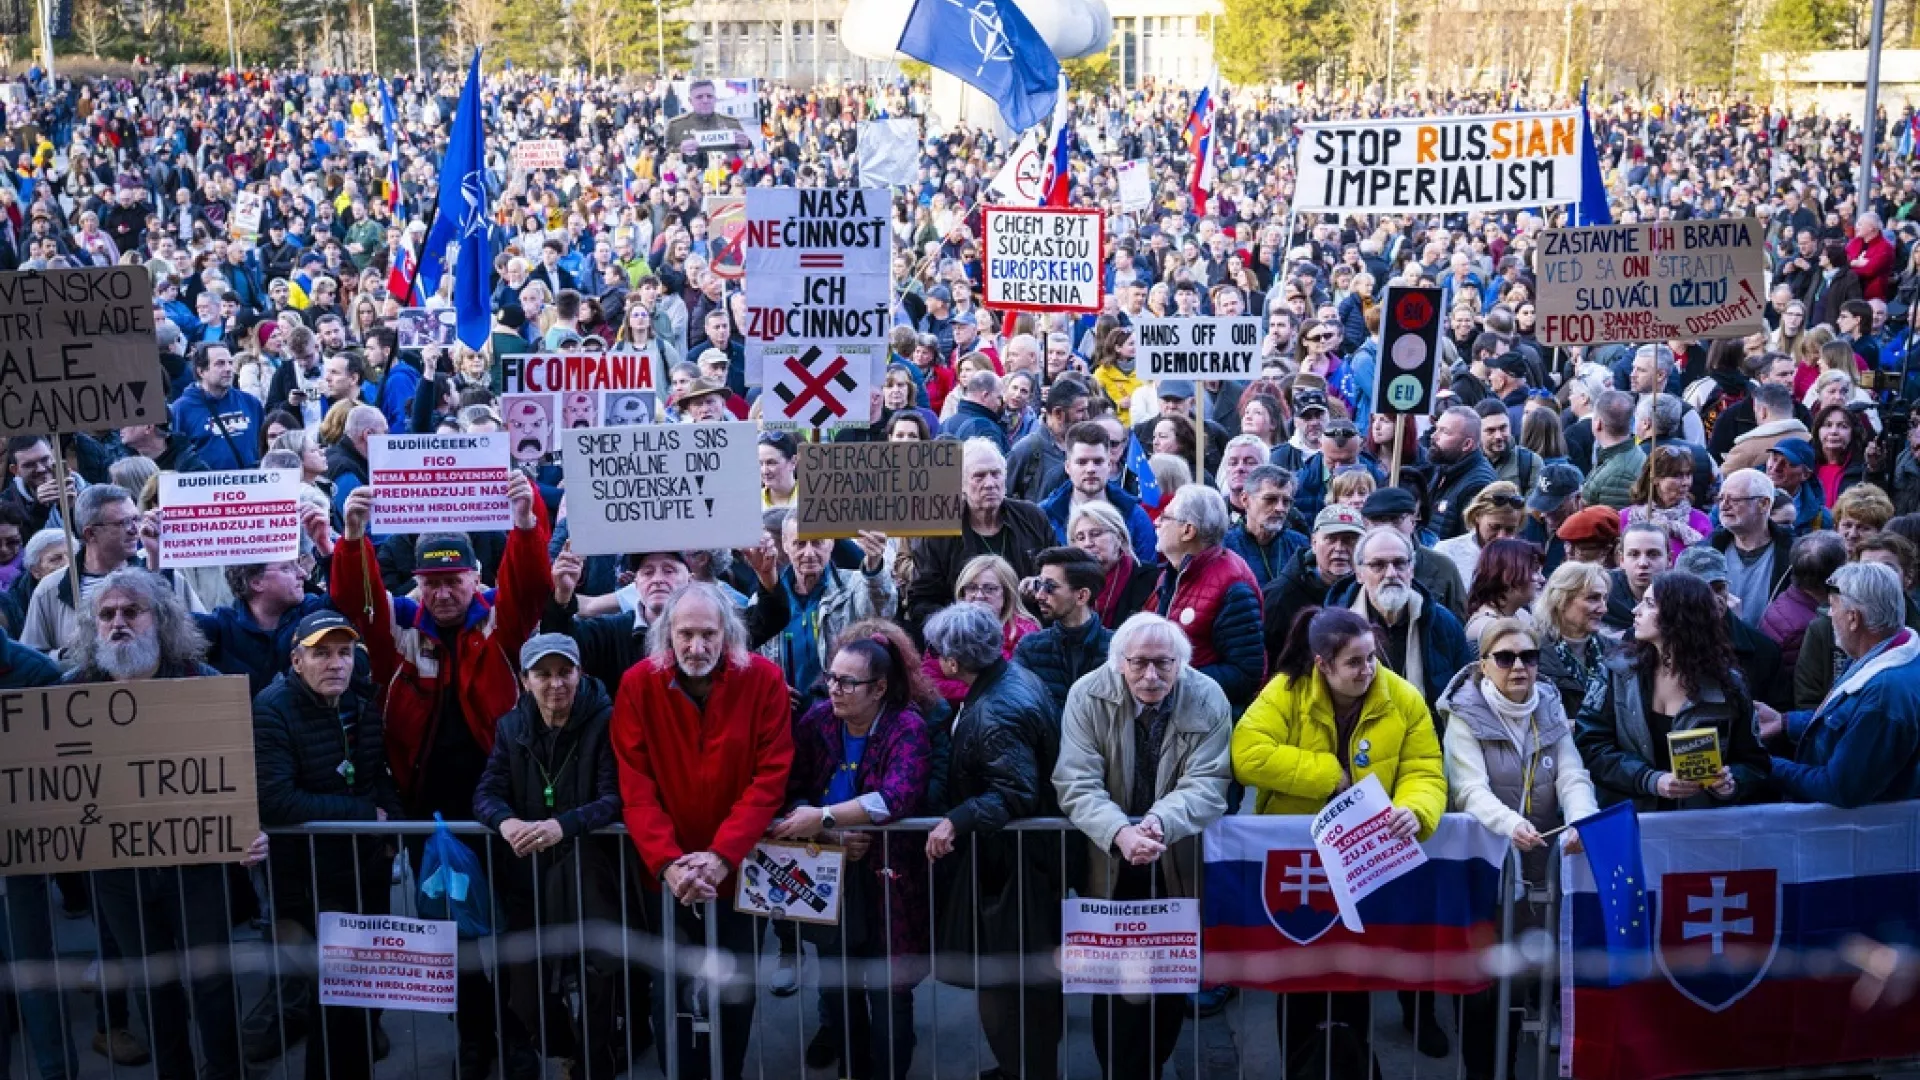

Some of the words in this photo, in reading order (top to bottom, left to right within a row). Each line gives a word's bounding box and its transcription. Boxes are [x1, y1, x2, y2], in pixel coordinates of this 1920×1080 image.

[701, 132, 728, 142] AGENT
[1314, 128, 1401, 166] STOP
[1324, 159, 1554, 206] IMPERIALISM
[799, 190, 867, 219] NAŠA
[747, 216, 885, 248] NEČINNOSŤ
[993, 214, 1043, 234] CHCEM
[1544, 227, 1639, 255] ZASTAVME
[1648, 225, 1675, 251] ICH
[1683, 223, 1751, 249] BRATIA
[991, 258, 1094, 282] EURÓPSKEHO
[1595, 257, 1616, 280] SA
[1623, 256, 1649, 279] ONI
[804, 276, 846, 305] ICH
[1002, 281, 1082, 304] RIEŠENIA
[1575, 280, 1659, 311] SLOVÁCI
[1670, 276, 1728, 307] OŽIJÚ
[63, 303, 151, 337] VLÁDE,
[747, 303, 889, 341] ZLOČINNOSŤ
[1141, 324, 1180, 346] HANDS
[1191, 323, 1217, 346] OFF
[1231, 323, 1257, 345] OUR
[0, 343, 96, 386] ALE
[501, 352, 653, 392] FICOMPÁNIA
[1151, 351, 1253, 373] DEMOCRACY
[1394, 384, 1415, 401] EU
[577, 433, 622, 455] SMER
[633, 430, 680, 451] HLAS
[693, 428, 728, 449] SNS
[423, 456, 457, 466] FICO
[589, 452, 669, 477] MORÁLNE
[686, 452, 721, 472] DNO
[806, 444, 901, 471] SMERÁCKE
[908, 443, 957, 468] OPICE
[374, 486, 475, 498] PREDHADZUJE
[480, 484, 509, 495] NÁS
[806, 469, 902, 494] VYPADNITE
[909, 470, 930, 492] DO
[213, 490, 247, 501] FICO
[163, 519, 265, 534] PREDHADZUJE
[269, 517, 297, 529] NÁS
[0, 688, 138, 733] FICO
[127, 756, 236, 798] TROLL
[80, 803, 102, 825] &
[108, 815, 243, 858] REKTOFIL
[1115, 922, 1147, 932] FICO
[373, 936, 406, 947] FICO
[1169, 948, 1197, 960] NÁS
